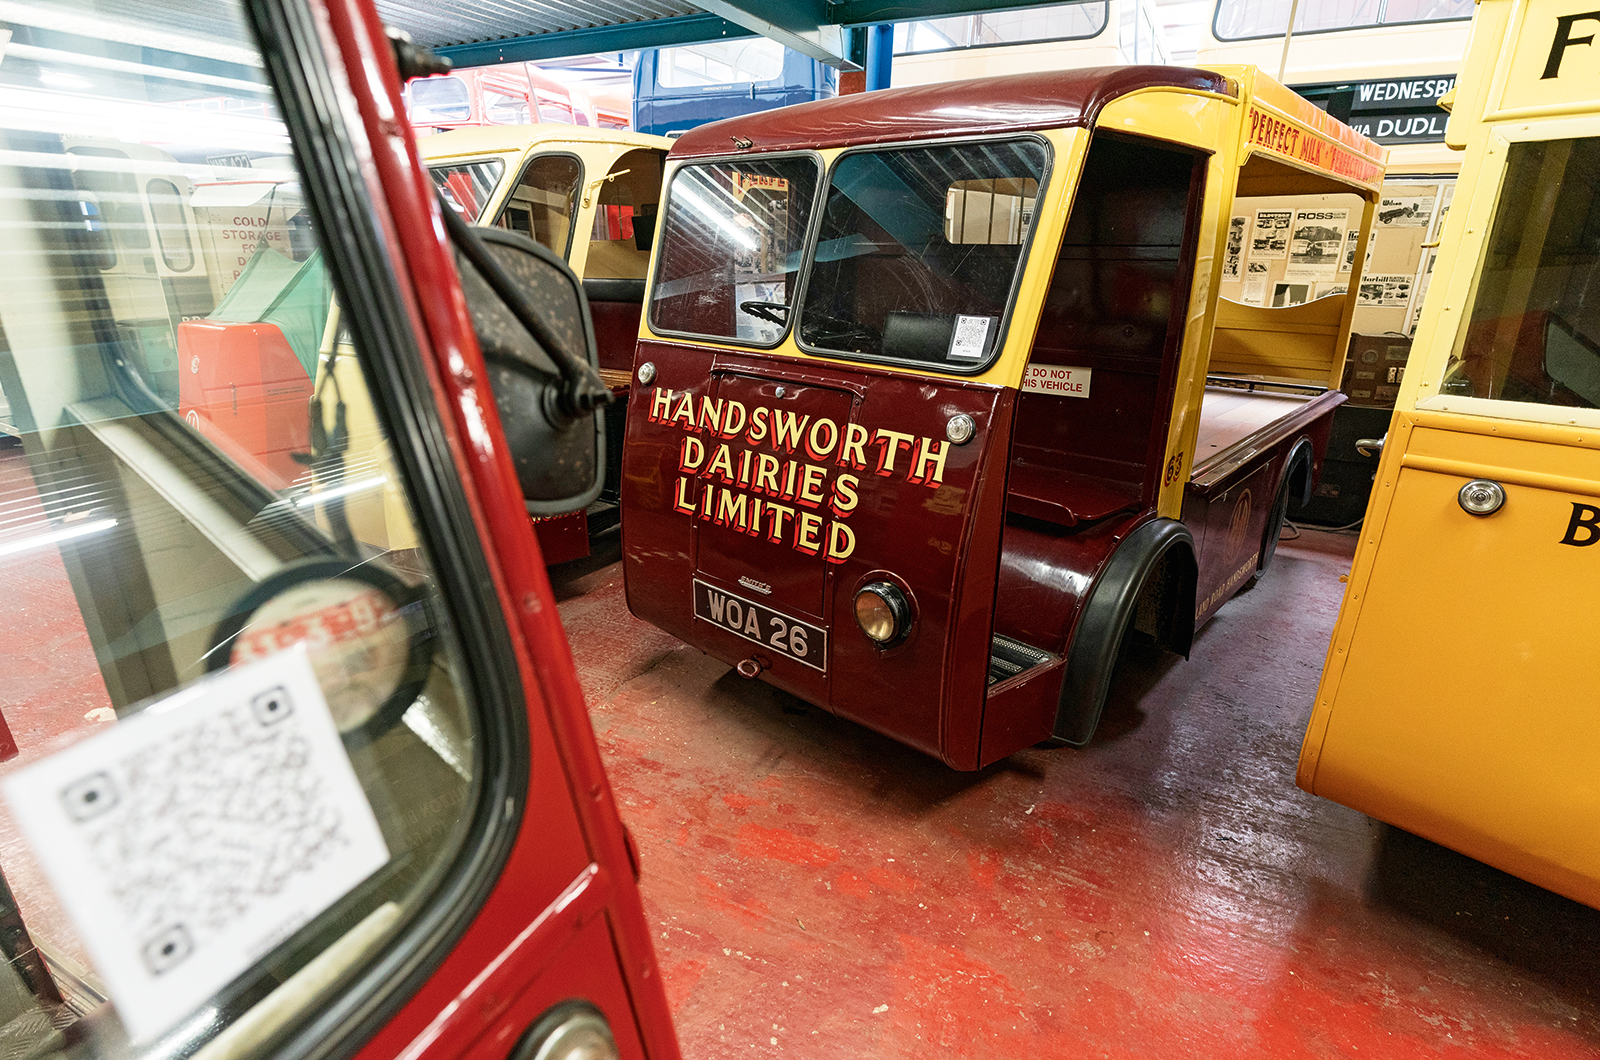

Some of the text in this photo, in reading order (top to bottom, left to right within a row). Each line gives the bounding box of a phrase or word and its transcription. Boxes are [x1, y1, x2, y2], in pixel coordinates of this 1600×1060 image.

[1540, 11, 1600, 80] F
[222, 229, 281, 241] STORAGE
[233, 216, 266, 227] COLD
[1297, 212, 1333, 220] ROSS
[1032, 368, 1047, 377] DO
[1050, 370, 1072, 379] NOT
[1040, 380, 1083, 392] VEHICLE
[648, 387, 951, 488] HANDSWORTH
[678, 436, 859, 518] DAIRIES
[673, 476, 856, 564] LIMITED
[1558, 501, 1600, 547] B
[707, 589, 808, 657] WOA 26
